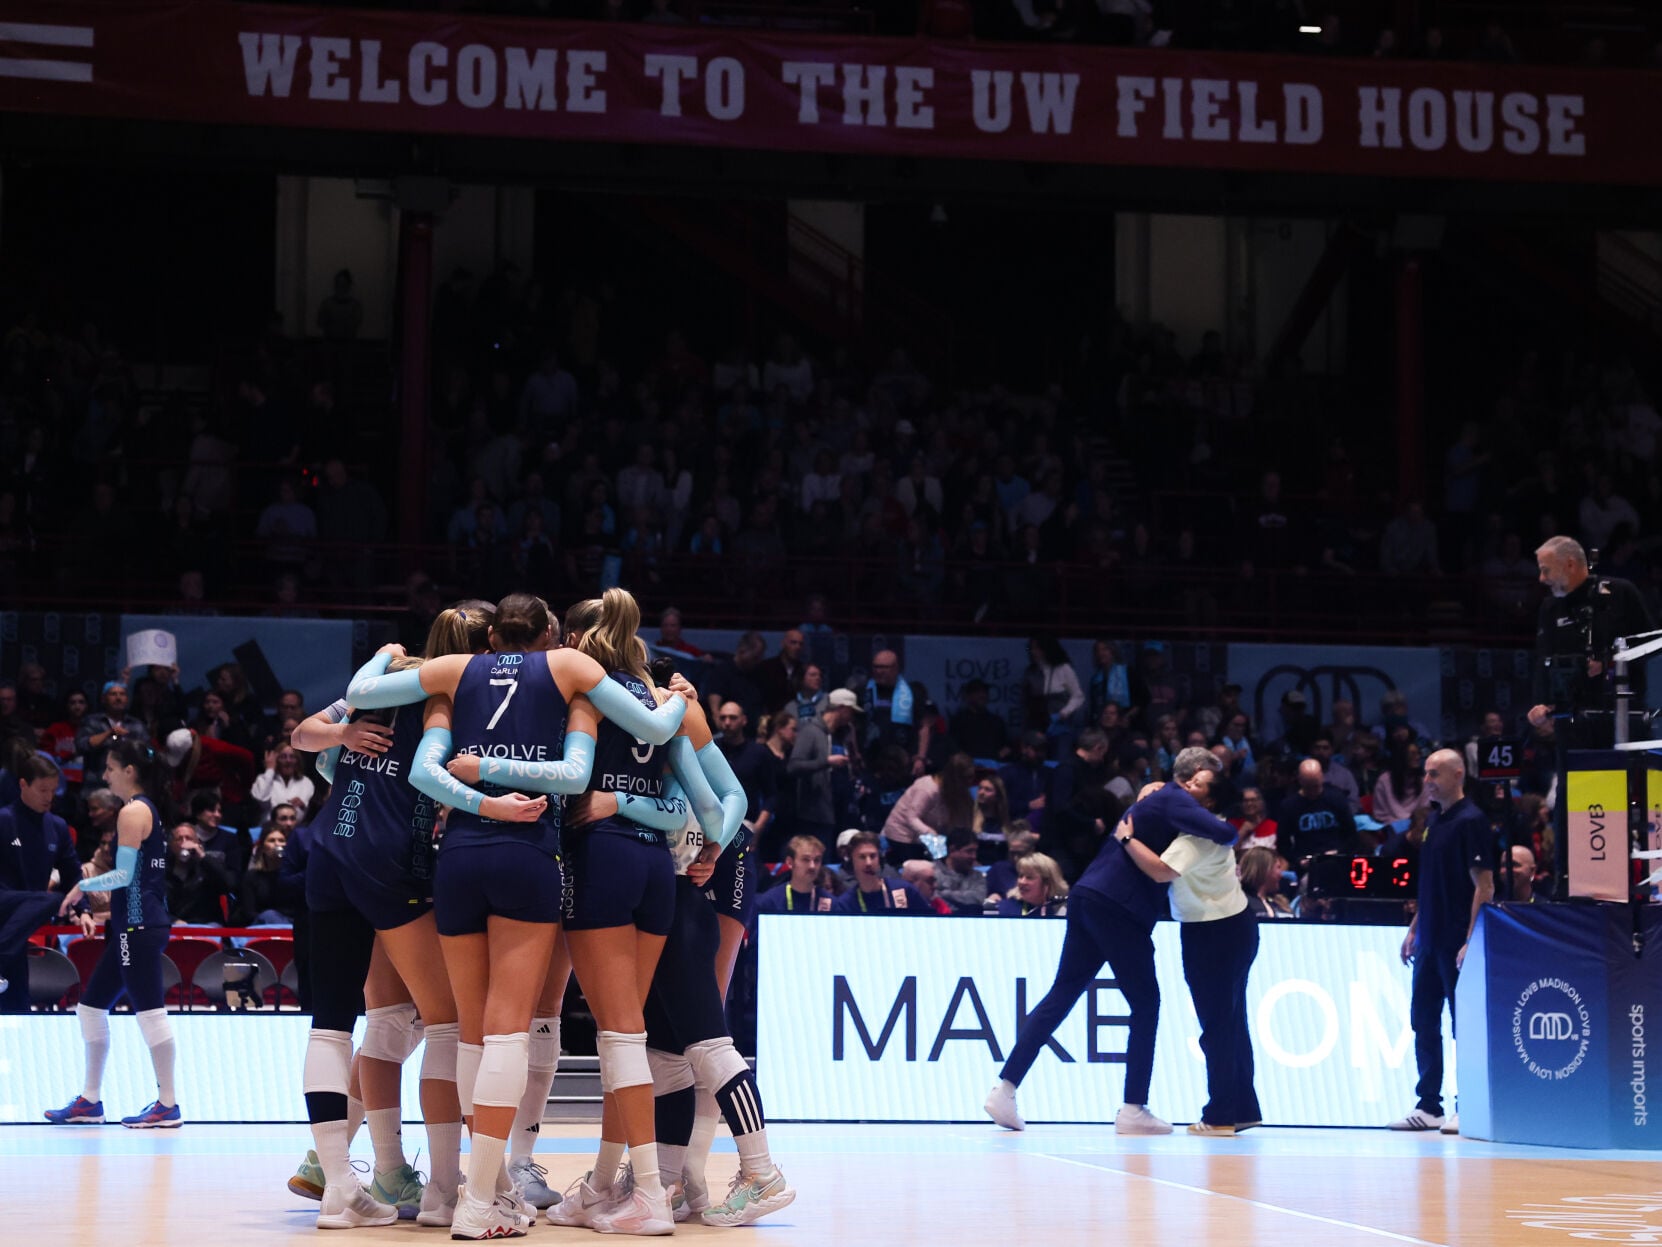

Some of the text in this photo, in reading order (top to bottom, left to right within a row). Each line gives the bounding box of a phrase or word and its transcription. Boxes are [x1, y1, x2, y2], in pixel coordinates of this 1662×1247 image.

[238, 32, 1586, 156] WELCOME TO THE UW FIELD HOUSE
[486, 678, 518, 730] 7
[601, 773, 663, 795] REVOLV
[1488, 745, 1513, 767] 45
[1588, 803, 1606, 862] LOVB
[1512, 977, 1591, 1080] LOVB MADISON LOVB MADISON LOVB MADISON
[1628, 1003, 1648, 1126] sports imports
